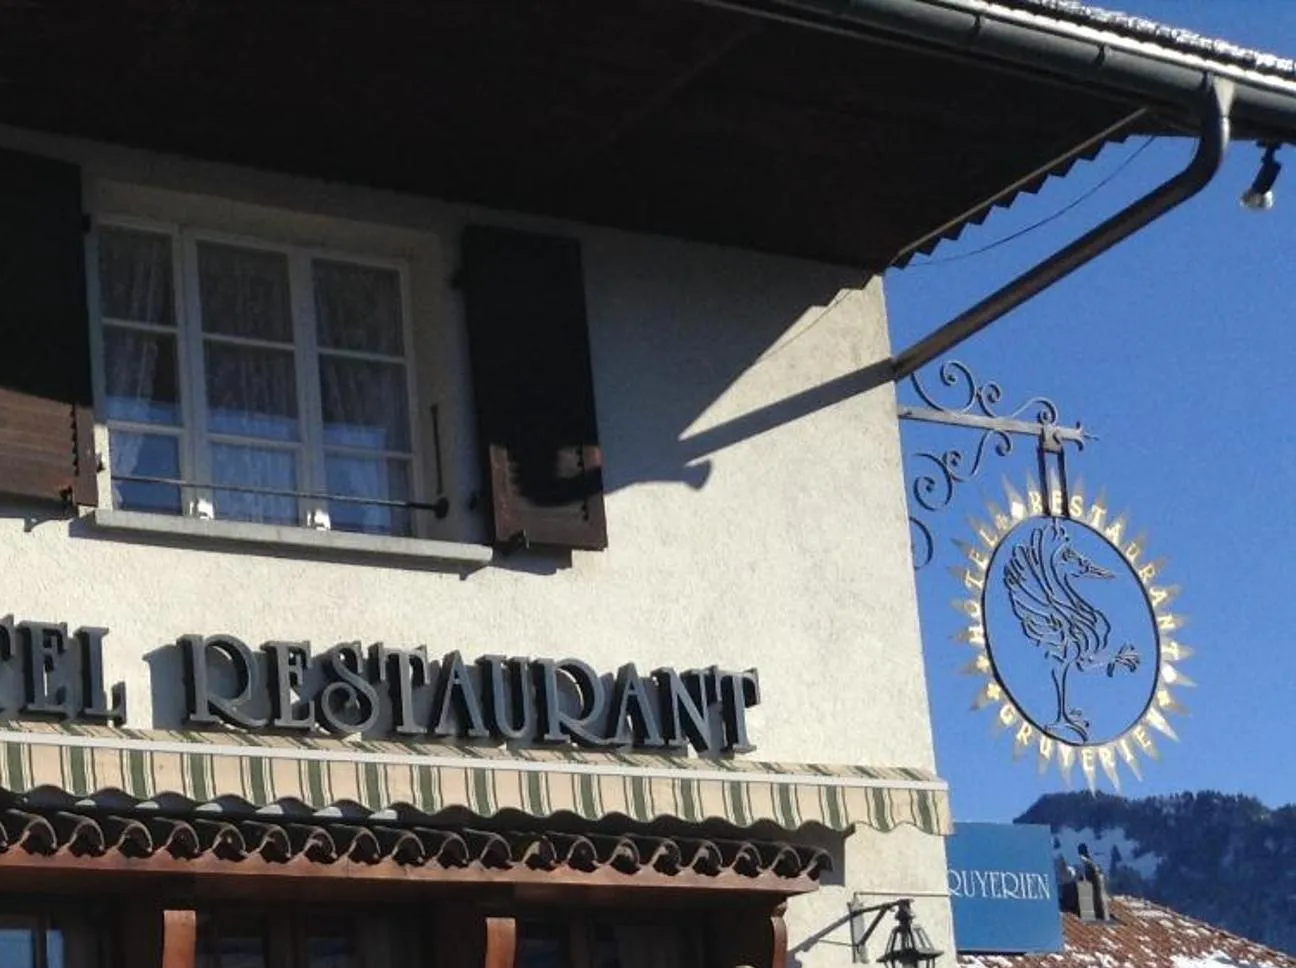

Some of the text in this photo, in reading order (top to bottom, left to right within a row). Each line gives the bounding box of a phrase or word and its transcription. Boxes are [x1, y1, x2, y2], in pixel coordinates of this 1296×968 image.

[965, 490, 1180, 661] HOTEL RESTAURANT
[177, 633, 759, 754] RESTAURANT
